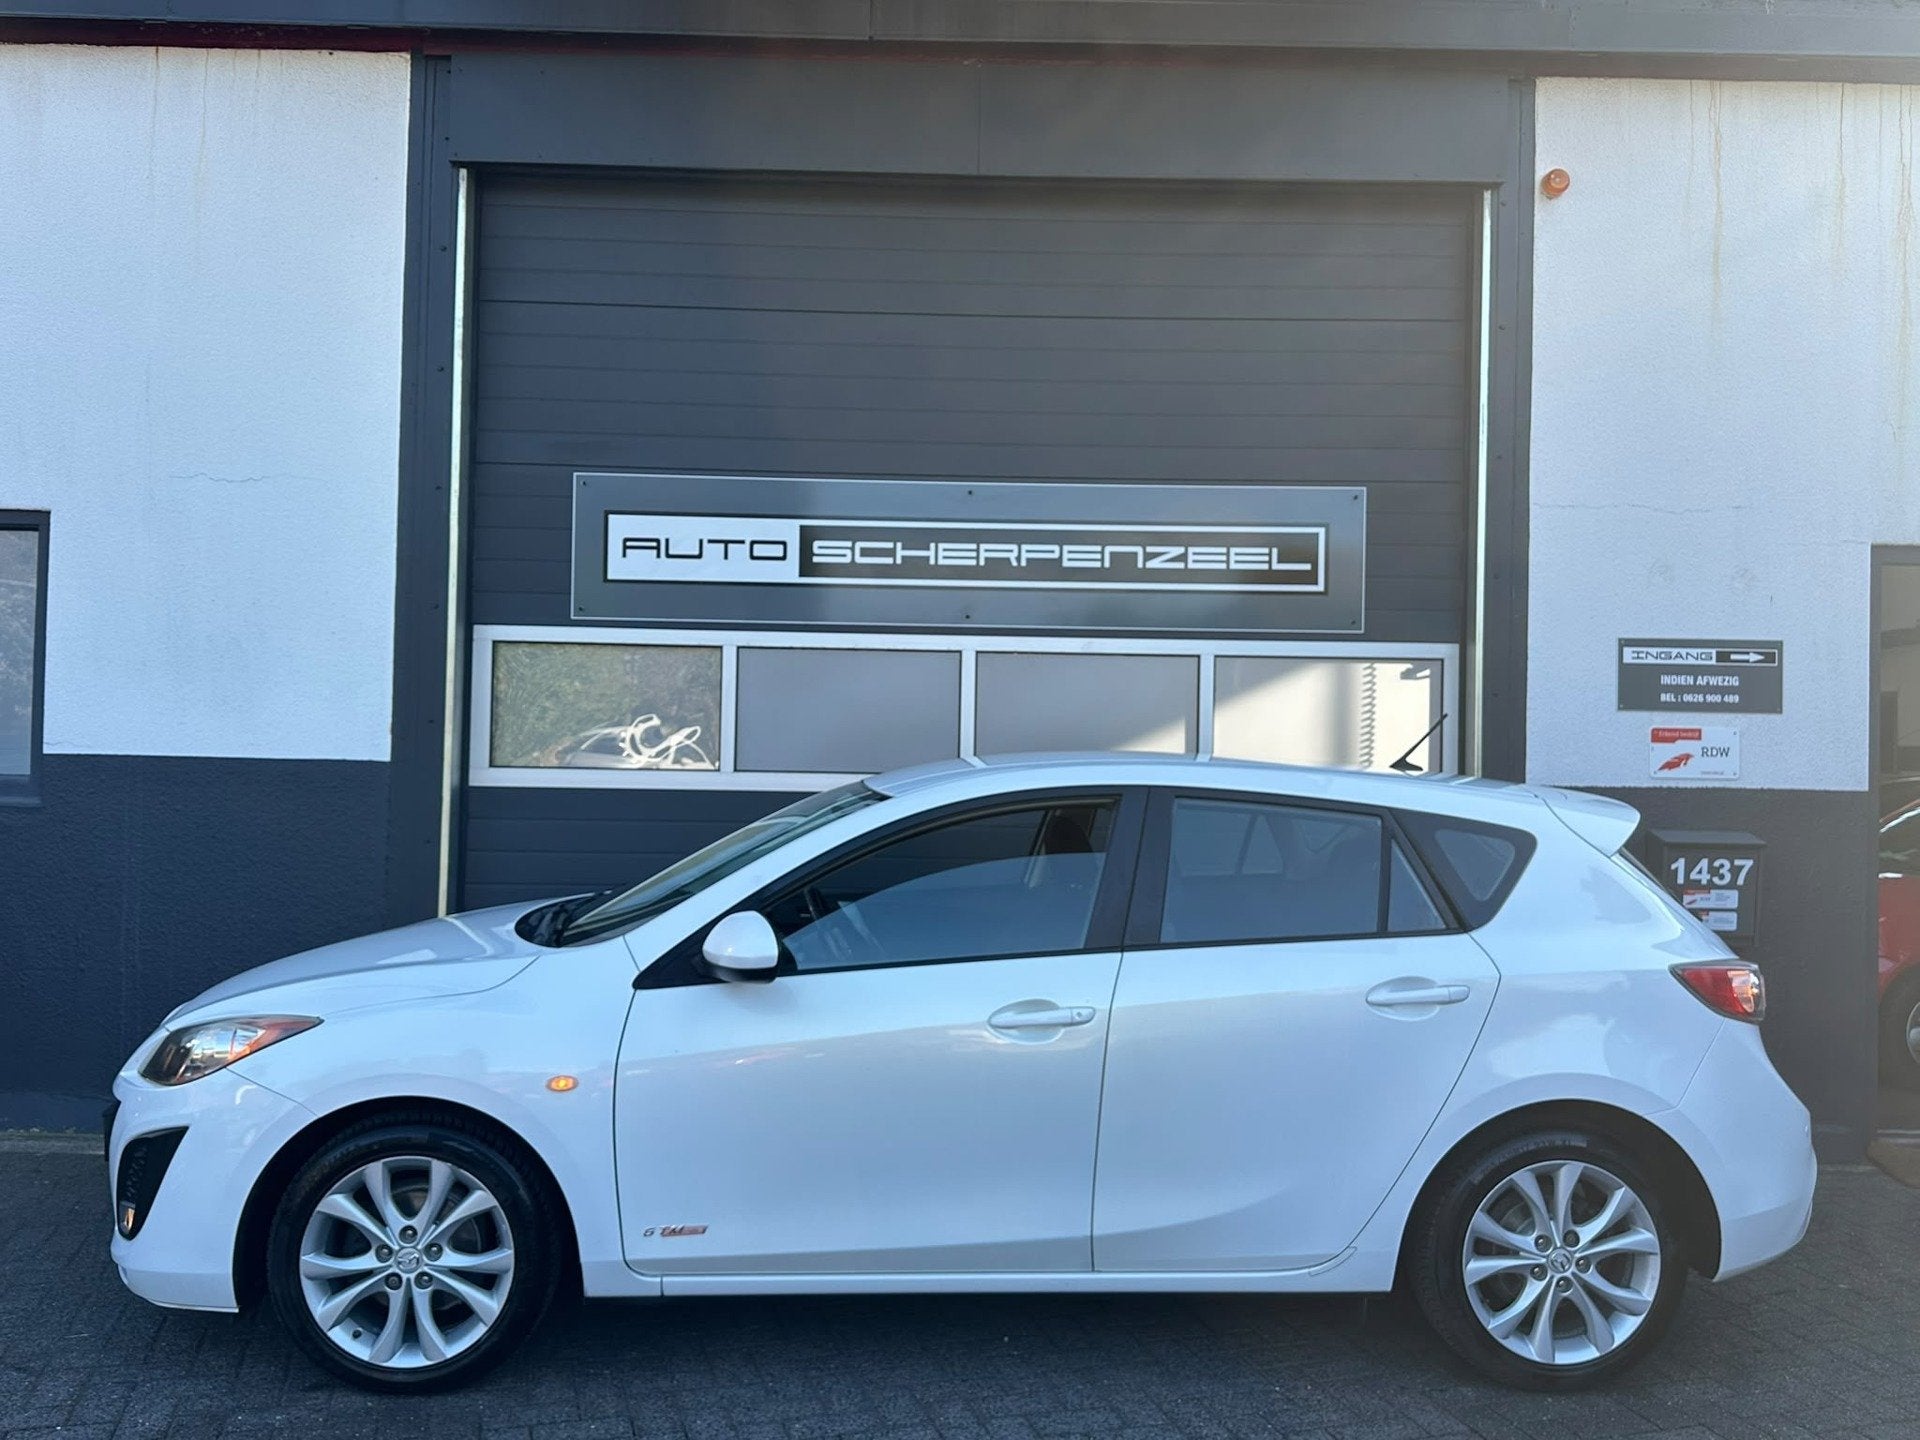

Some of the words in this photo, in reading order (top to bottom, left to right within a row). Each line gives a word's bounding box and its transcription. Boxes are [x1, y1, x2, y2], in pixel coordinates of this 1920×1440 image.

[622, 537, 788, 560] AUTO
[811, 540, 1311, 571] SCHERPENZEEL
[1631, 650, 1713, 661] INGANG
[1696, 675, 1739, 686] AFWEZIG
[1660, 693, 1676, 702] BEL
[1705, 694, 1722, 703] 900
[1701, 747, 1730, 758] RDW
[1670, 857, 1754, 886] 1437
